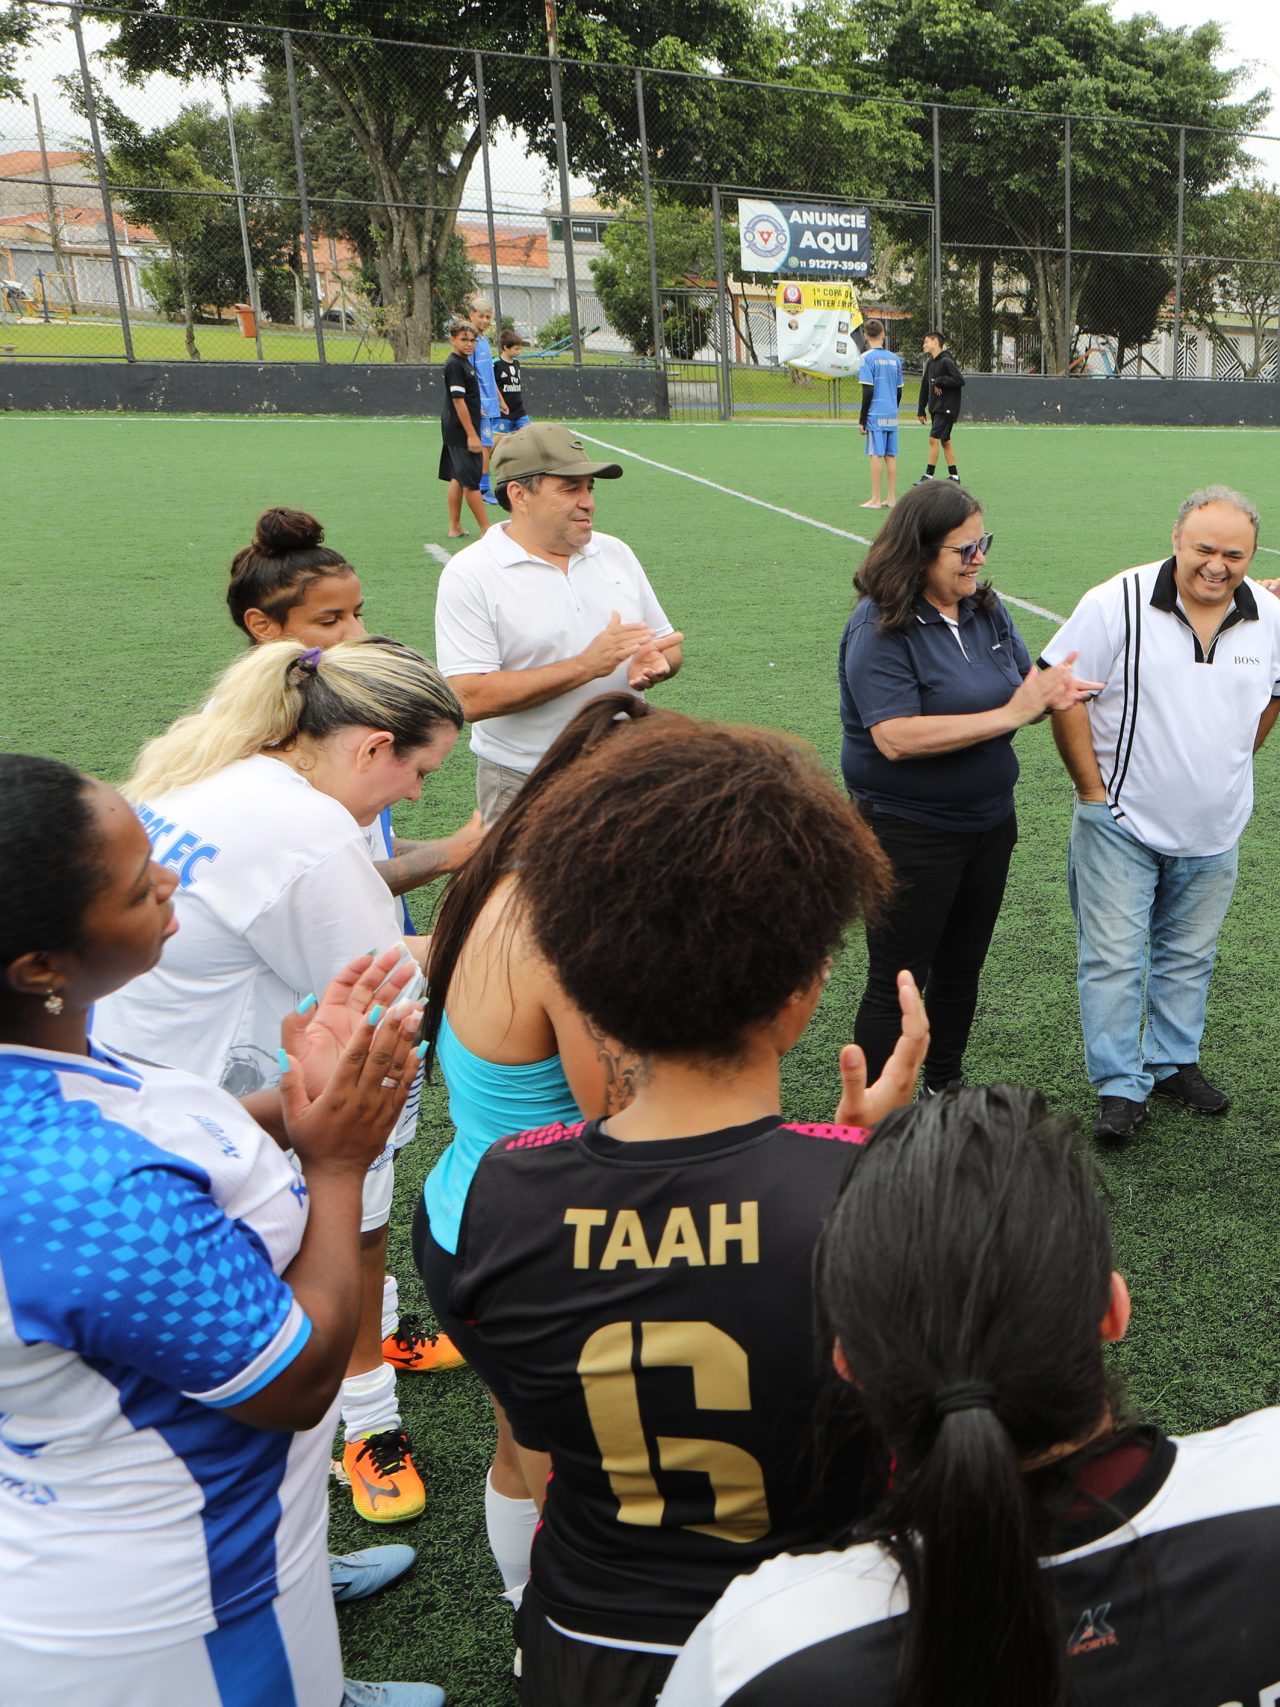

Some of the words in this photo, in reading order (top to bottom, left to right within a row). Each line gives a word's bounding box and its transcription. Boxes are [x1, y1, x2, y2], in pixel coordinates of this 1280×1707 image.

[789, 209, 866, 229] ANUNCIE
[799, 230, 858, 254] AQUI
[808, 258, 868, 271] 91277-3969
[823, 288, 842, 297] COPA
[813, 299, 836, 308] INTER
[1233, 656, 1260, 664] BOSS
[563, 1200, 760, 1271] TAAH
[577, 1320, 771, 1544] 6
